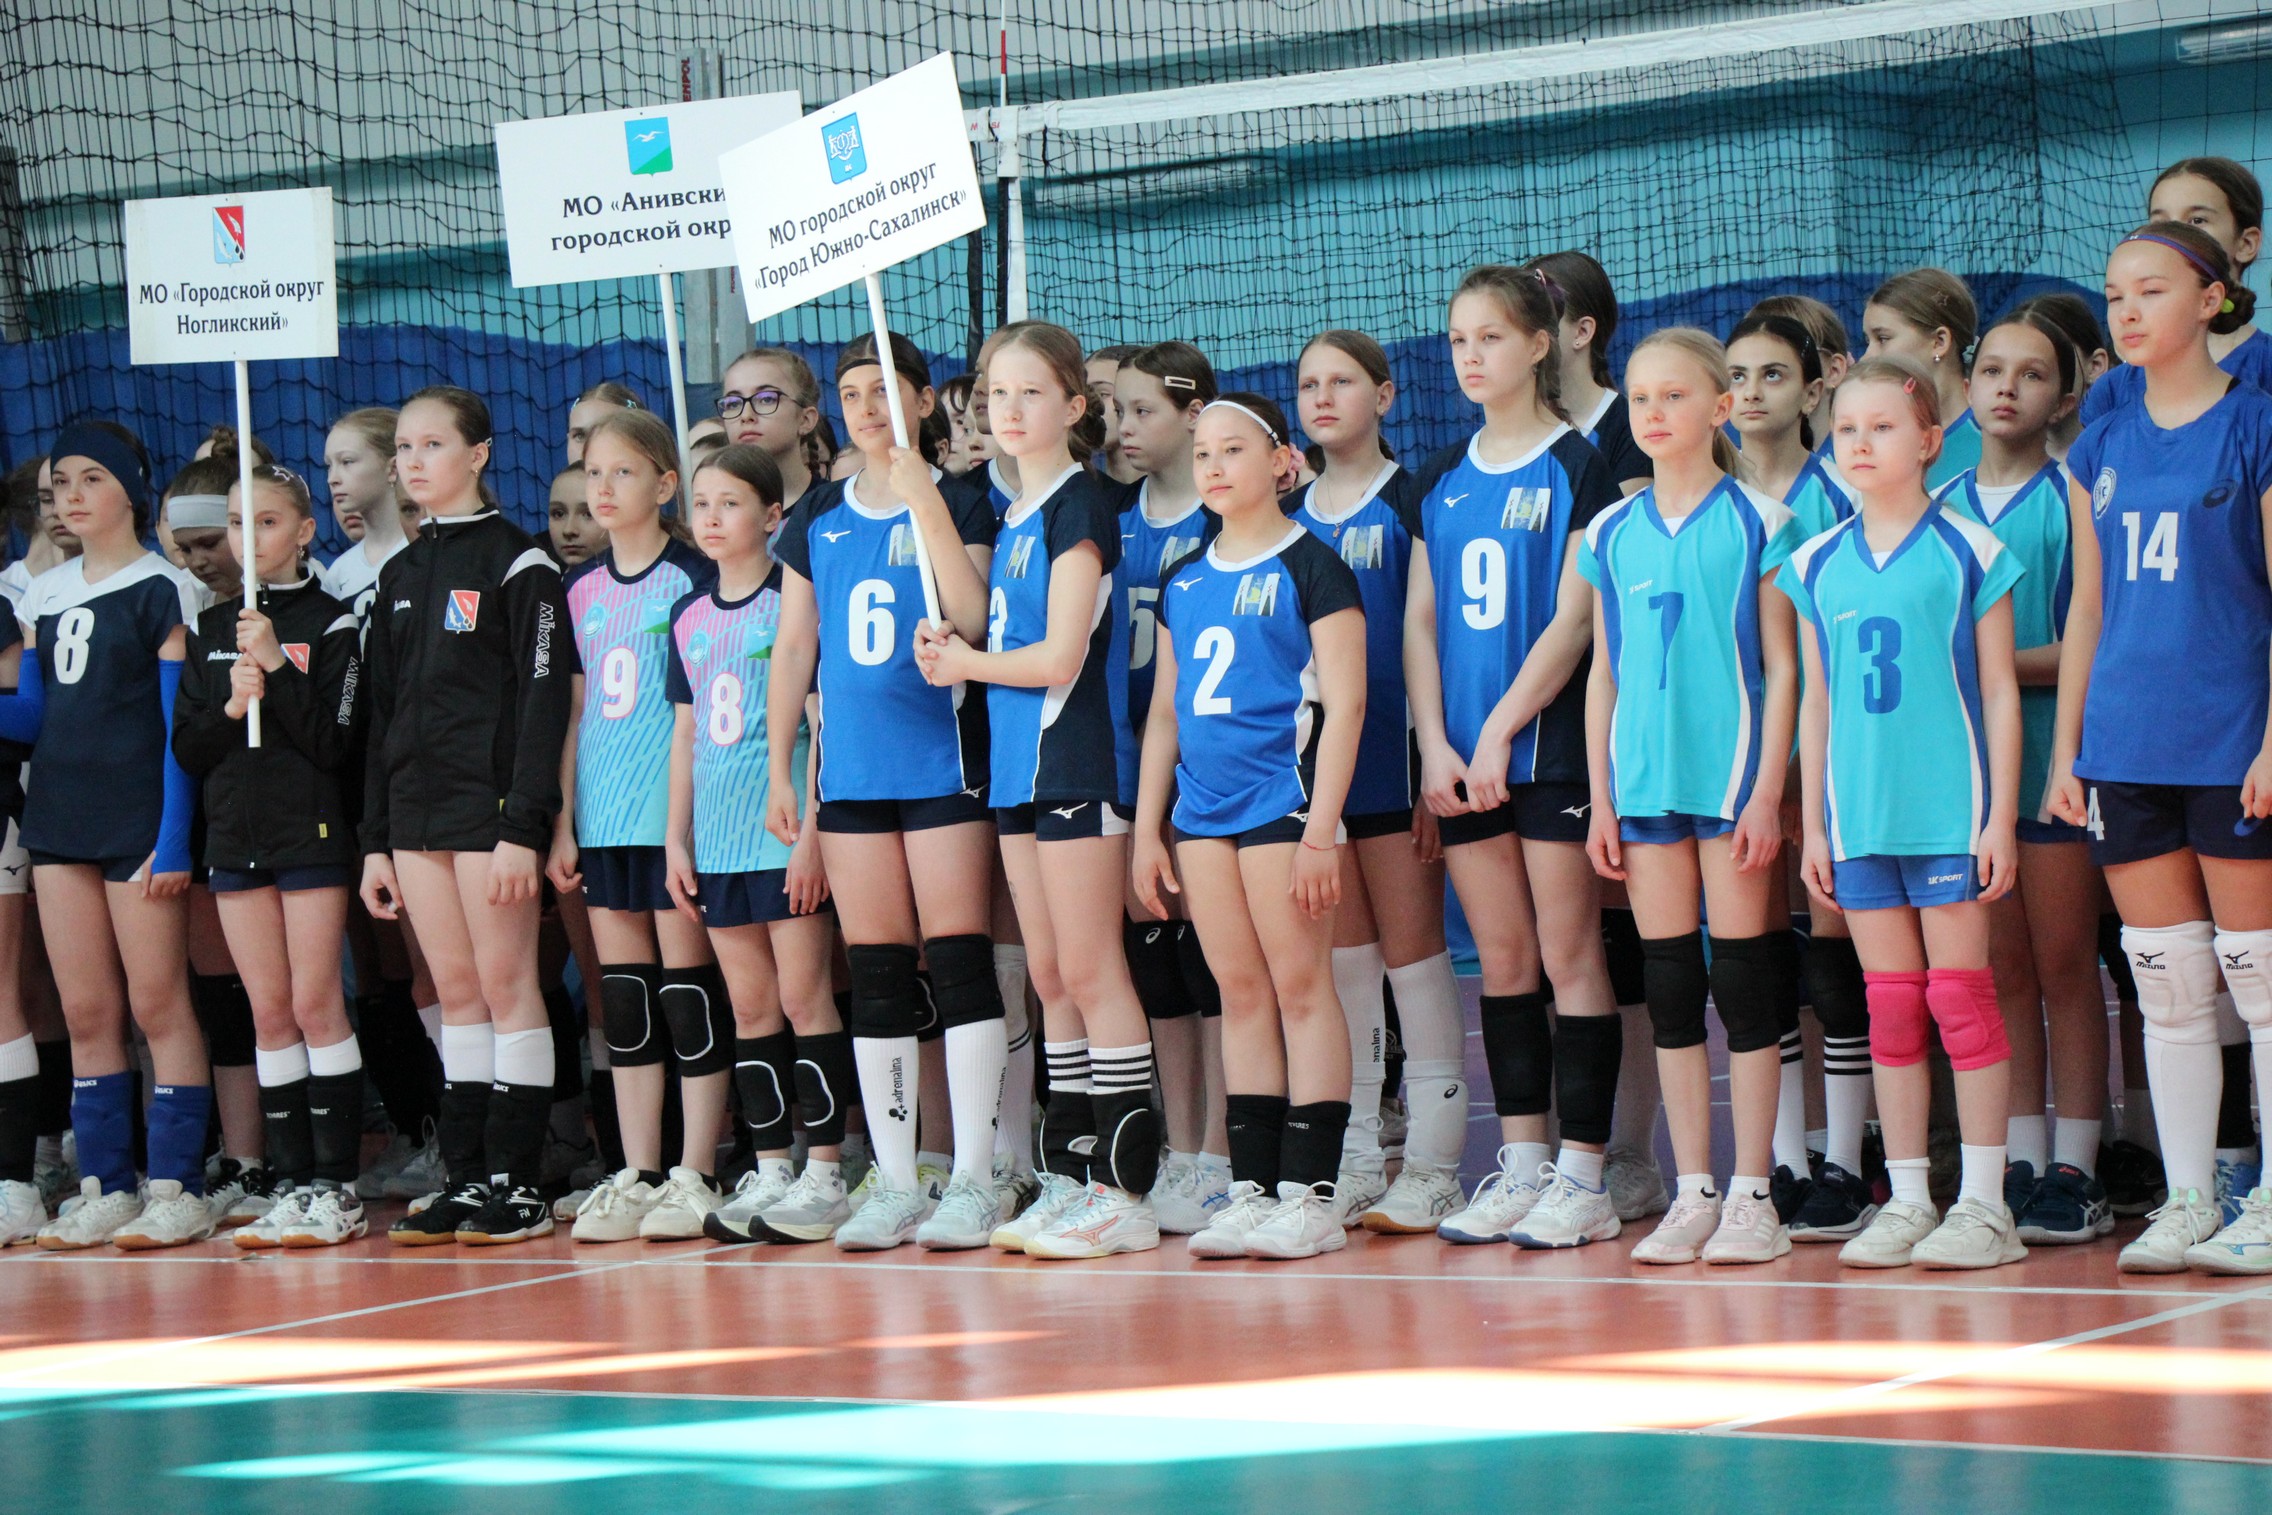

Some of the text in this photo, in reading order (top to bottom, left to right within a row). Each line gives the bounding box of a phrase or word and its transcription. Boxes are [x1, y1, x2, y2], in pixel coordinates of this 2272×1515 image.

[551, 218, 732, 254] городской окр
[563, 195, 603, 218] МО
[755, 256, 810, 290] «Город
[810, 189, 967, 267] Южно-Сахалинск»
[768, 162, 937, 249] МО городской округ
[139, 279, 325, 307] МО «Городской округ
[177, 311, 289, 334] Ногликский»
[1461, 537, 1506, 631] 9
[2121, 511, 2179, 582] 14
[53, 607, 95, 685] 8
[533, 601, 556, 678] MIKASA
[848, 579, 895, 666] 6
[1648, 591, 1684, 691] 7
[337, 656, 359, 726] MIKASA
[602, 645, 638, 720] 9
[1193, 625, 1235, 716] 2
[1857, 616, 1902, 715] 3
[709, 671, 744, 746] 8
[2086, 786, 2105, 841] 4
